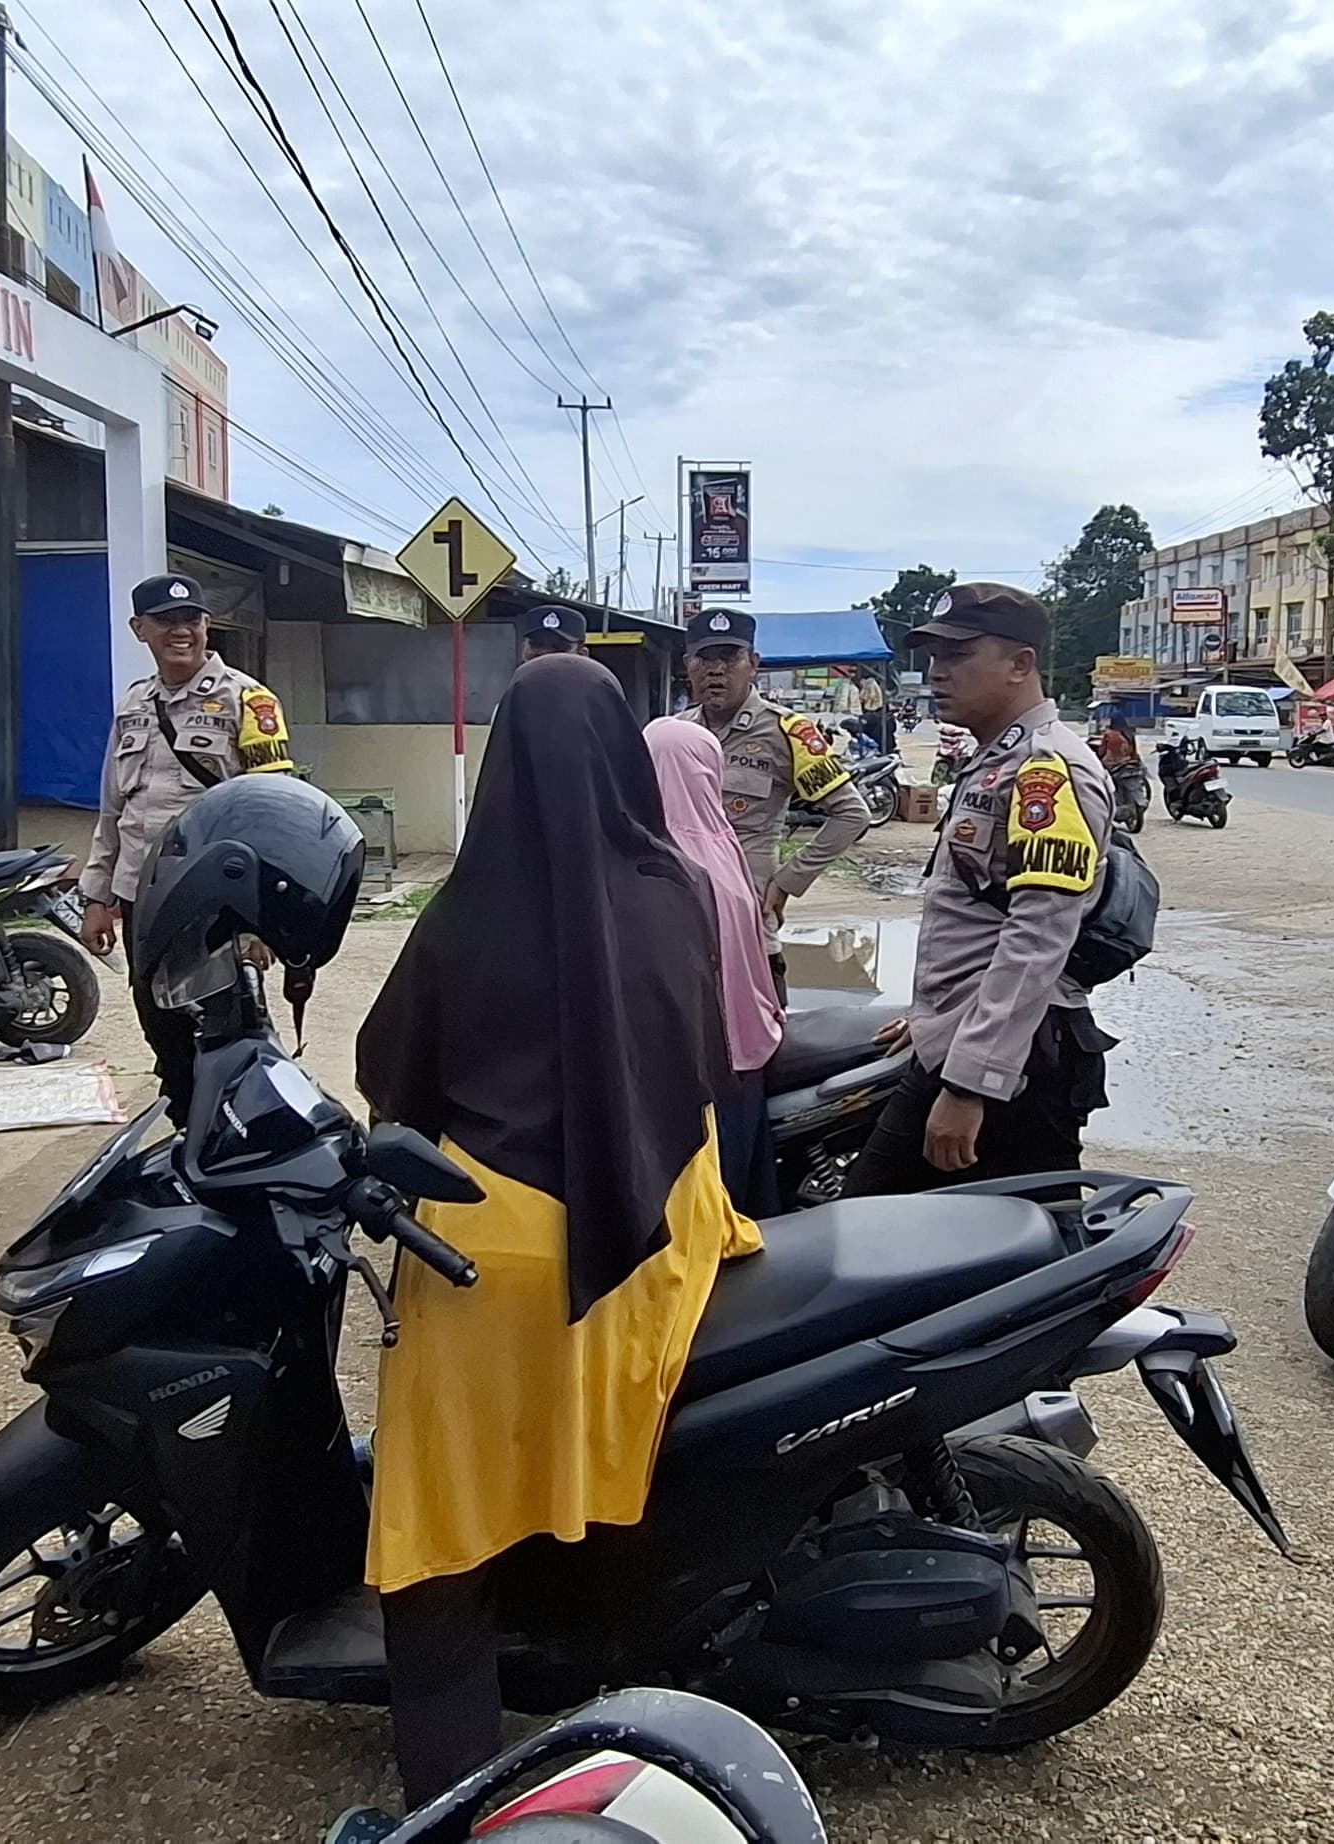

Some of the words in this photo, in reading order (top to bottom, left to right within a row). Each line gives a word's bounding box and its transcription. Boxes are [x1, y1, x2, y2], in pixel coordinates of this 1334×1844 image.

[185, 715, 227, 728] POLRI
[729, 755, 769, 770] POLRI
[961, 790, 994, 812] POLRI
[222, 1101, 248, 1139] HONDA
[148, 1365, 231, 1402] HONDA
[776, 1386, 917, 1455] VARIO
